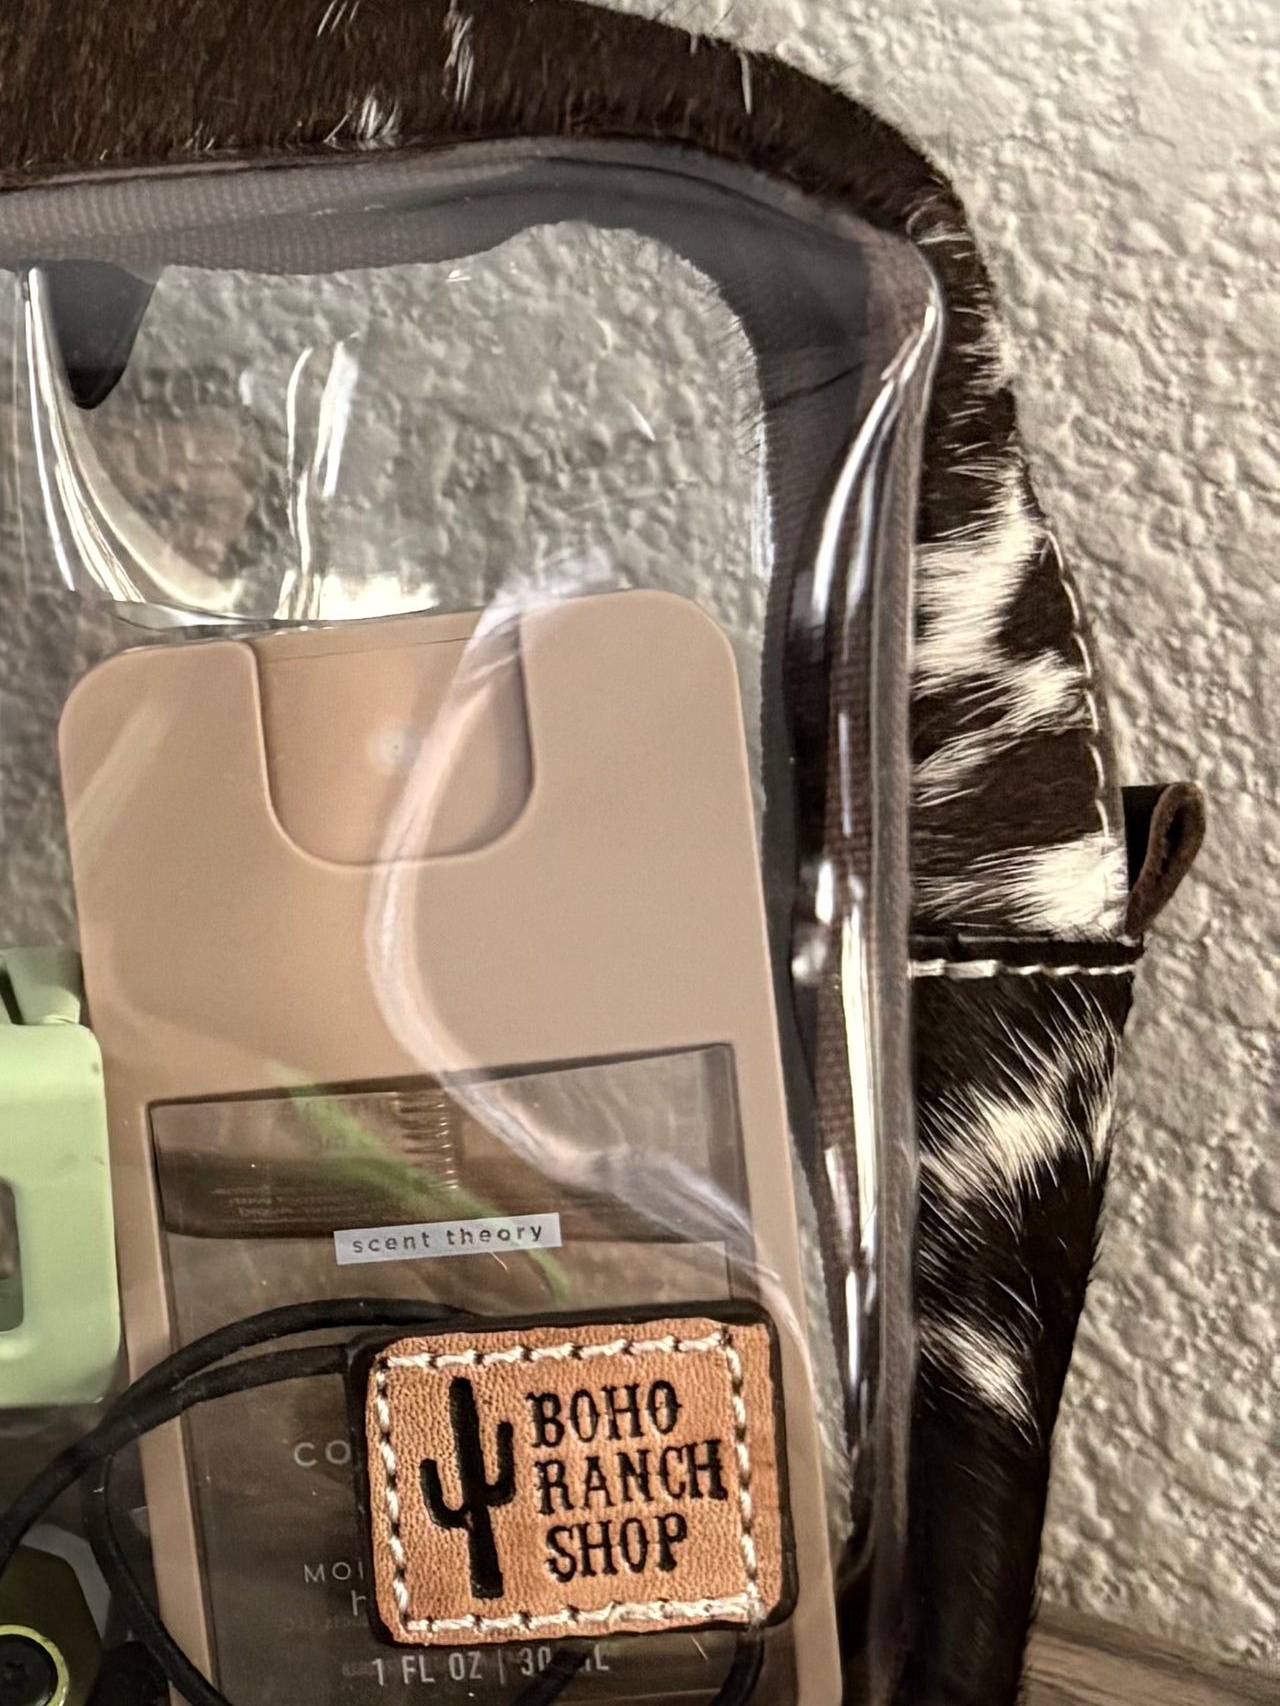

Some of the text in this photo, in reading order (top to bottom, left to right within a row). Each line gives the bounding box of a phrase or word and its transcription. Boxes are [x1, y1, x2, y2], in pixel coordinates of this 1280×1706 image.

[352, 1224, 542, 1253] scent theory
[526, 1380, 682, 1448] BOHO
[533, 1439, 728, 1516] RANCH
[545, 1512, 687, 1583] SHOP
[371, 1657, 385, 1687] 1
[401, 1654, 435, 1685] FL
[448, 1650, 483, 1681] OZ
